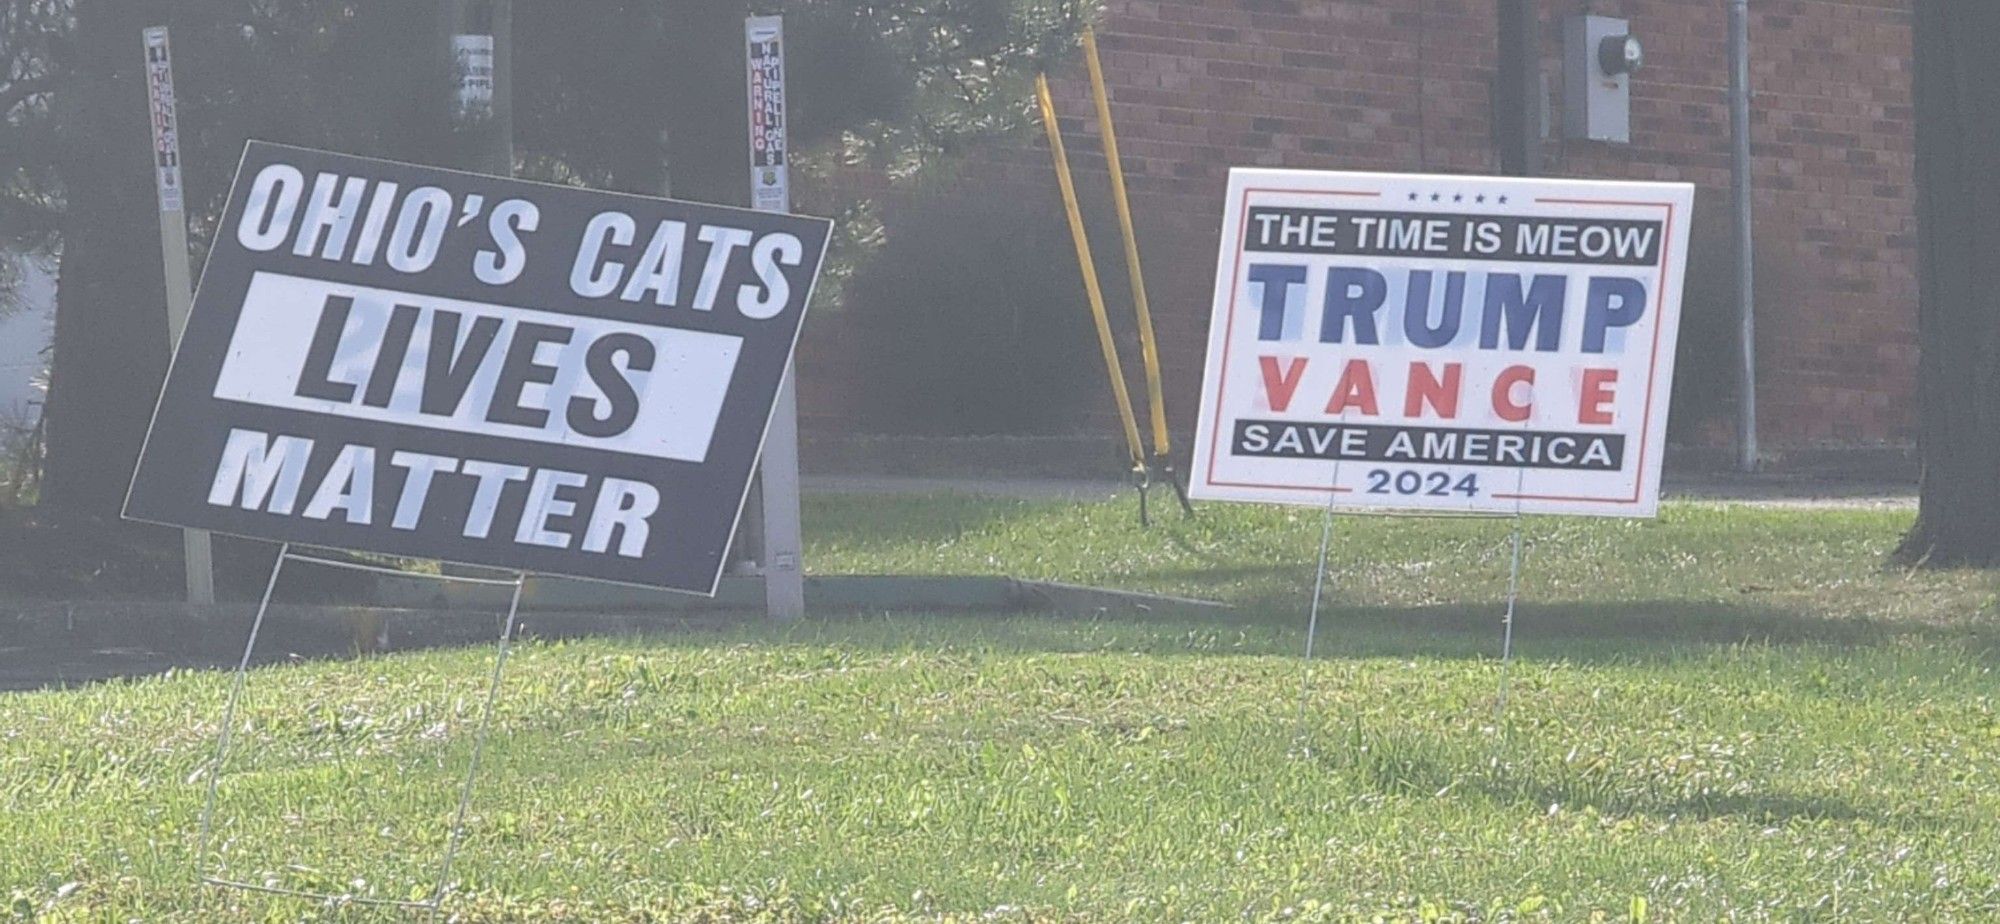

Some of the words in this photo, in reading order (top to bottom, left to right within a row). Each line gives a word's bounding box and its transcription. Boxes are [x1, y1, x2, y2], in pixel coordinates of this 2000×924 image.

[751, 57, 765, 151] WARNING
[762, 42, 775, 126] NATURAL
[765, 129, 775, 166] GAS
[236, 163, 541, 286] OHIO'S
[568, 210, 803, 320] CATS
[1255, 213, 1338, 248] THE
[1351, 217, 1451, 252] TIME
[1463, 220, 1502, 254] IS
[1515, 223, 1655, 259] MEOW
[1248, 263, 1648, 354] TRUMP
[294, 293, 658, 439] LIVES
[1257, 355, 1619, 425] VANCE
[1240, 424, 1369, 456] SAVE
[1384, 431, 1614, 467] AMERICA
[1366, 468, 1480, 498] 2024
[207, 427, 661, 559] MATTER
